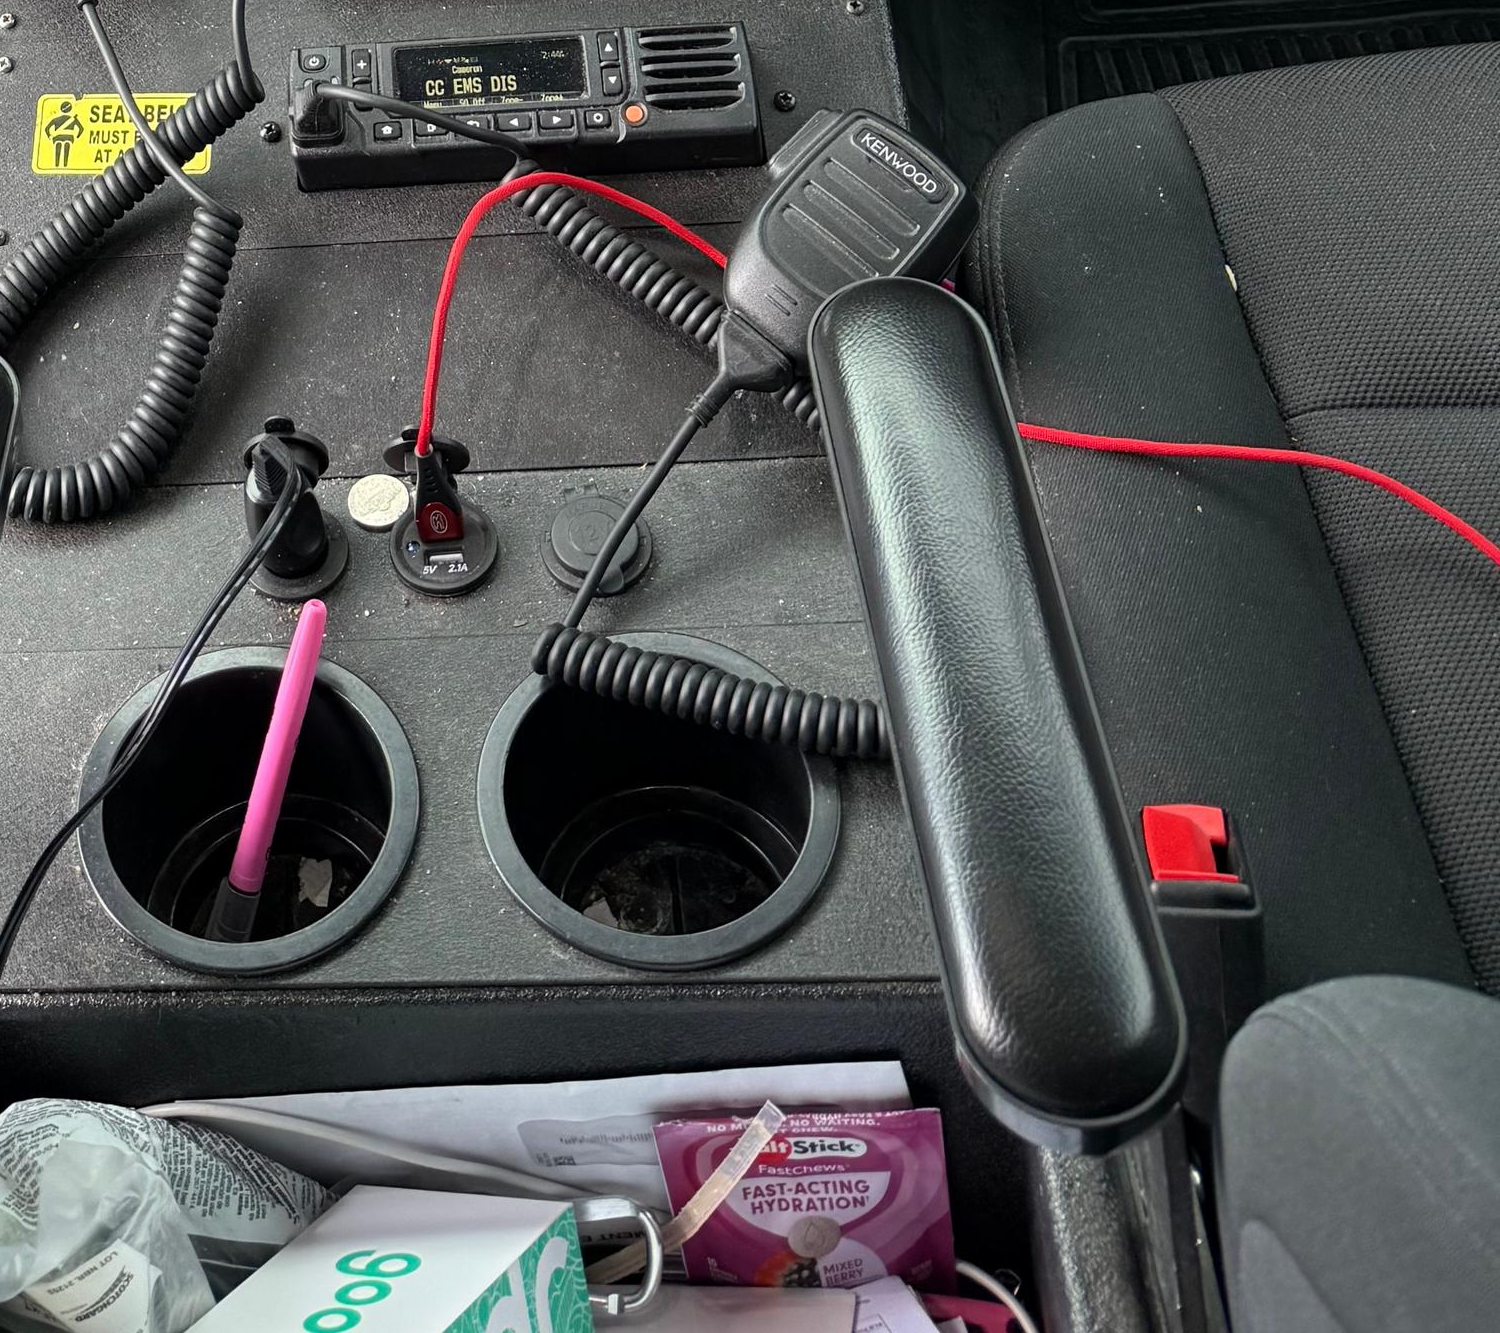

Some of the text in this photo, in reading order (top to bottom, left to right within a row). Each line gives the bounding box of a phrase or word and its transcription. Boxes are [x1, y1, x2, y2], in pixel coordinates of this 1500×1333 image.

[425, 74, 517, 96] CC EMS DIS
[90, 104, 133, 123] SEA
[89, 130, 130, 145] MUST
[94, 149, 112, 163] AT
[861, 132, 938, 194] KENWOOD
[423, 563, 468, 574] 5V 2.1A
[706, 1124, 727, 1133] NO
[789, 1116, 881, 1128] NO WAITING.
[758, 1164, 847, 1175] FastChews
[742, 1179, 871, 1201] FAST-ACTING
[751, 1195, 866, 1215] HYDRATION
[100, 1251, 118, 1267] LOT
[823, 1257, 863, 1276] MIXED
[824, 1269, 864, 1284] BERRY
[75, 1270, 134, 1322] SCOTCHGARD
